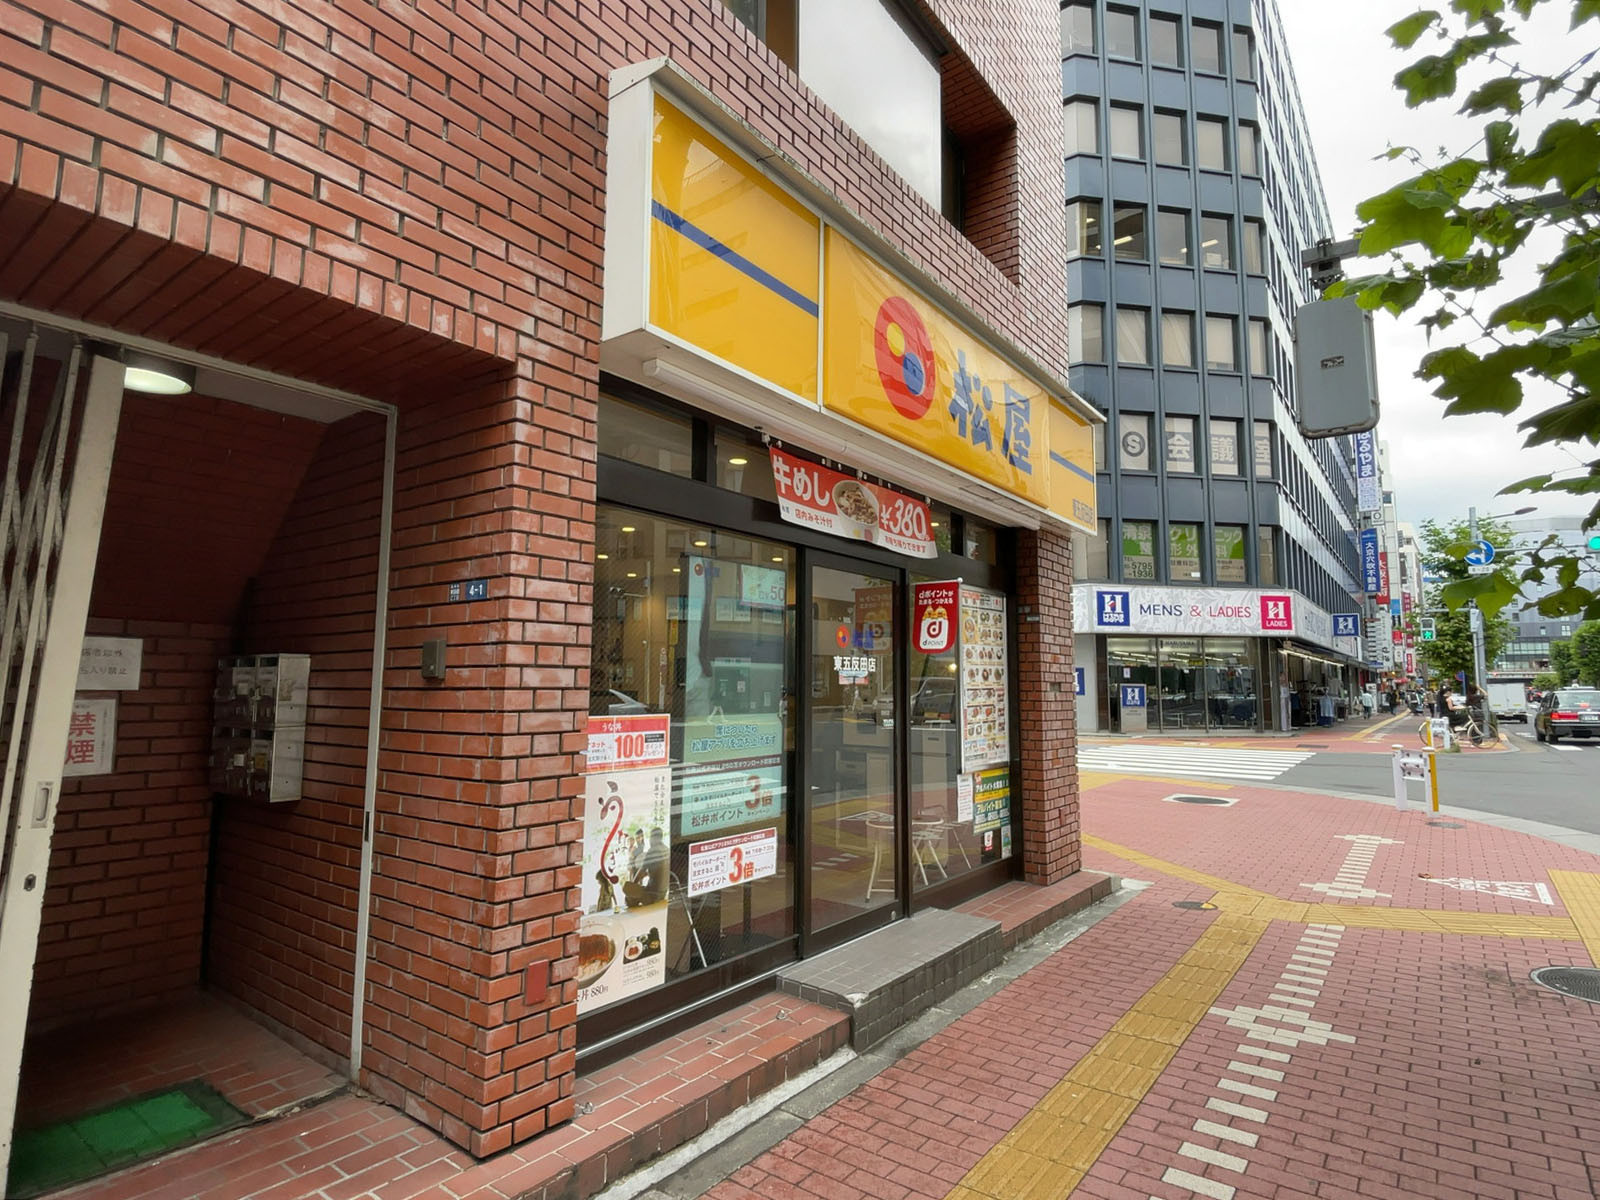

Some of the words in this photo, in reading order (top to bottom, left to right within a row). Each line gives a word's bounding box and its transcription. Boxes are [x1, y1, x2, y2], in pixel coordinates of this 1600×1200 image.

[948, 348, 1033, 476] 松屋
[772, 454, 831, 508] 牛めし
[794, 508, 833, 529] 店内みそ汁付
[880, 498, 927, 541] ¥380
[1365, 542, 1377, 591] 大京穴吹不動産
[469, 583, 483, 596] 4-1
[918, 588, 954, 599] dポイントが
[1139, 604, 1183, 617] MENS
[1190, 605, 1202, 617] &
[1209, 606, 1251, 618] LADIES
[833, 655, 876, 672] 東五反田店
[65, 712, 97, 765] 禁煙
[614, 733, 644, 759] 100
[691, 809, 743, 828] 松弁ポイント
